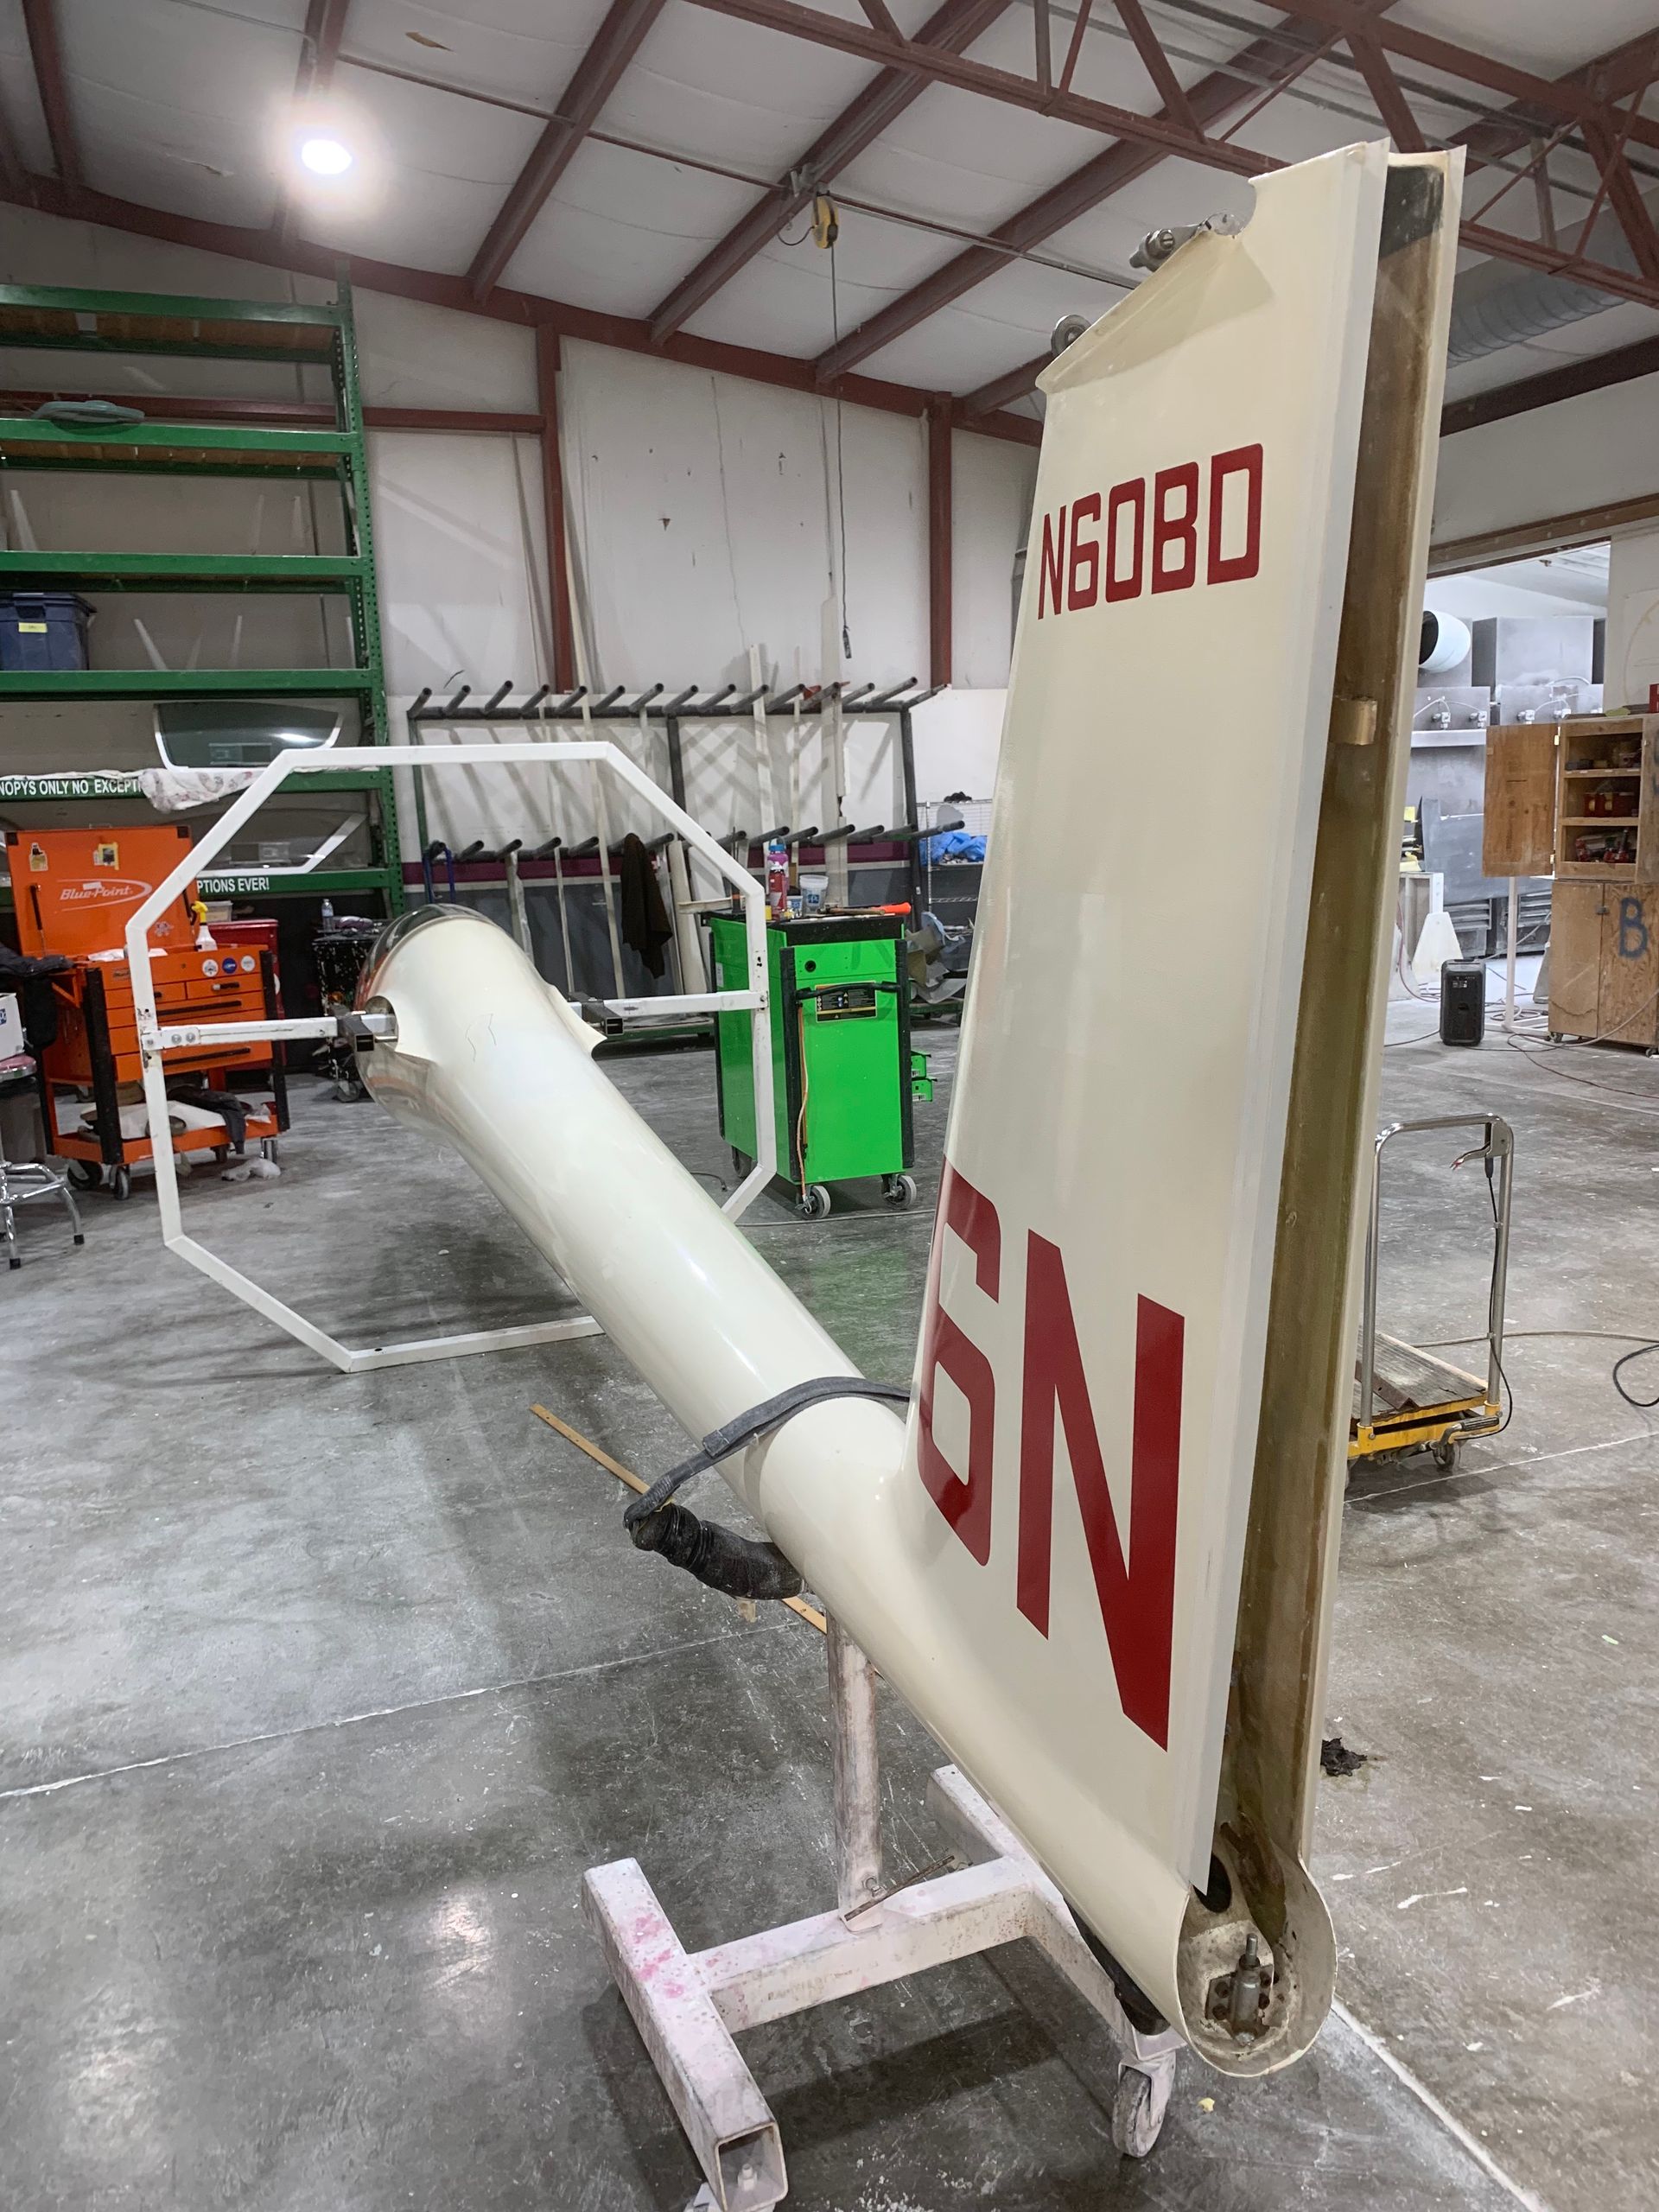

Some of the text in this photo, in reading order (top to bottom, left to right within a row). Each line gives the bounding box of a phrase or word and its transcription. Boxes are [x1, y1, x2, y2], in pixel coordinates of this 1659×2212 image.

[39, 779, 70, 795] ONLY
[72, 779, 89, 794] NO
[197, 877, 270, 893] PTIONS EVER!
[1618, 896, 1648, 961] B
[918, 1154, 1185, 1752] 6N
